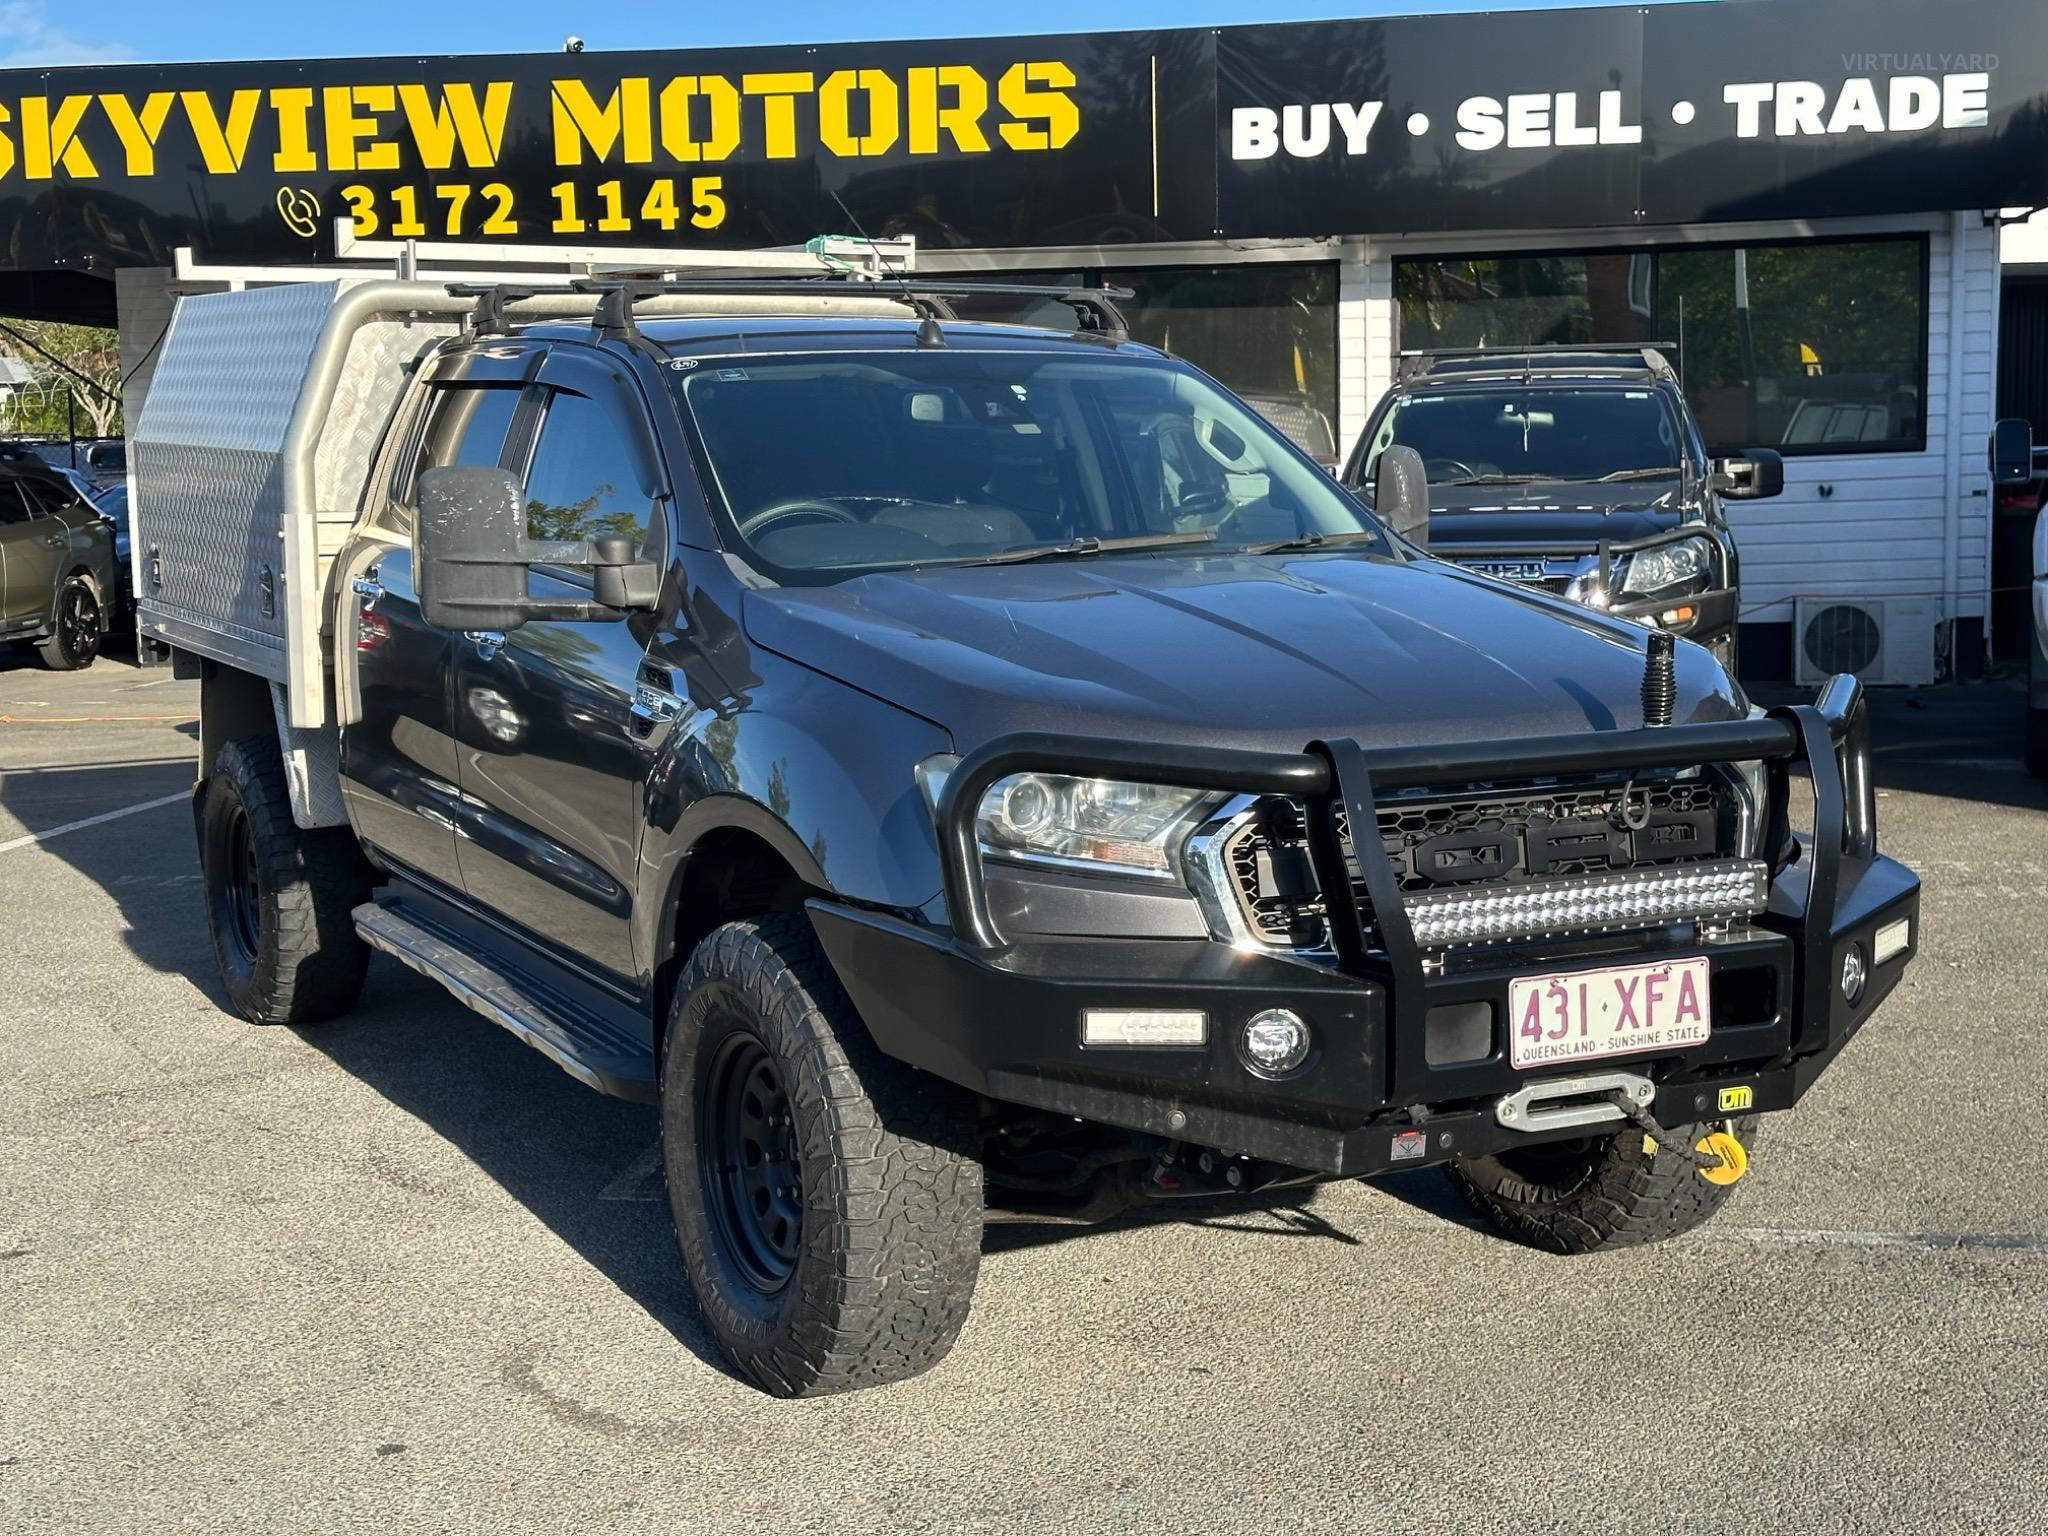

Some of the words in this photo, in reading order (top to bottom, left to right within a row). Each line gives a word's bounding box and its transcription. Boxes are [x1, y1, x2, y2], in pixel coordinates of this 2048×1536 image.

[0, 82, 513, 180] KYVIEW
[552, 61, 1080, 166] MOTORS
[1232, 102, 1383, 160] BUY
[1456, 91, 1643, 151] SELL
[1724, 73, 1989, 138] TRADE
[341, 184, 518, 237] 3172
[552, 177, 726, 233] 1145
[1521, 983, 1587, 1042] 431
[1614, 970, 1701, 1031] XFA
[1523, 1040, 1596, 1061] QUEENSLAND
[1608, 1031, 1660, 1050] SUNSHINE
[1667, 1027, 1700, 1042] STATE
